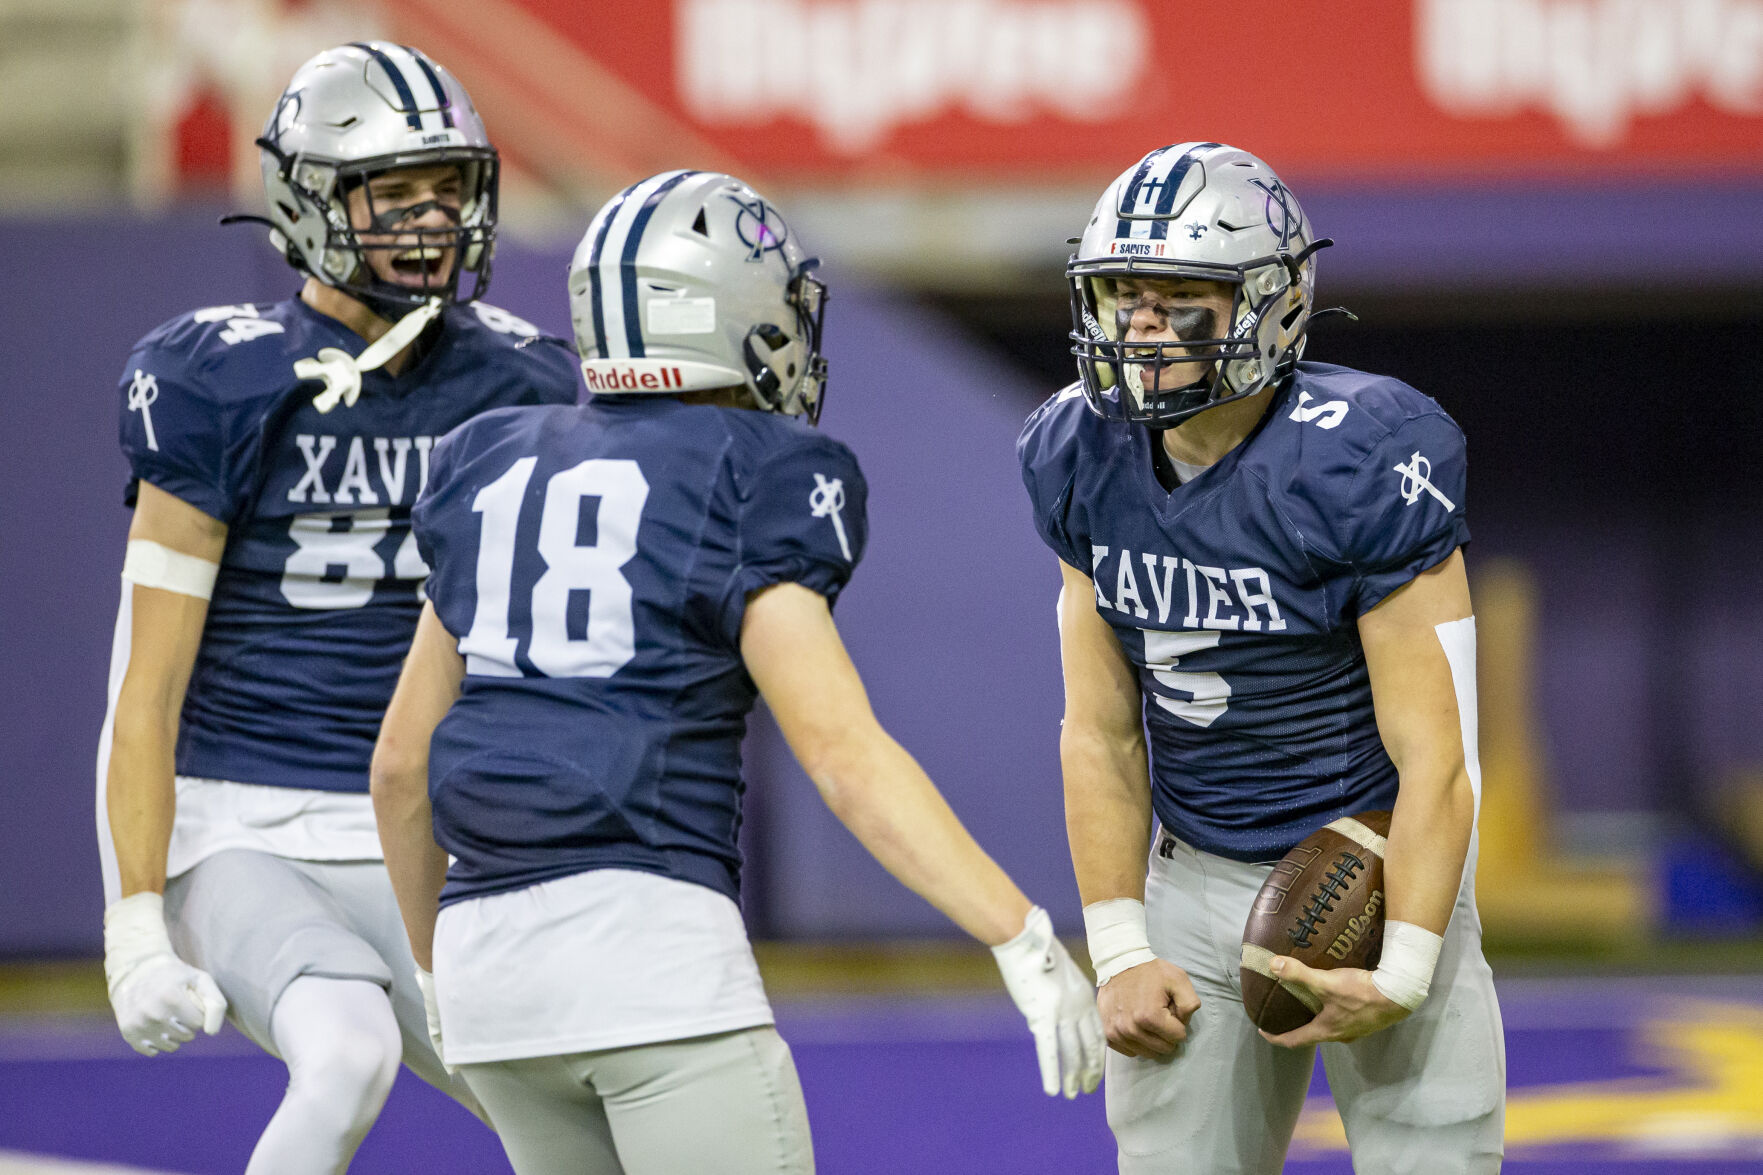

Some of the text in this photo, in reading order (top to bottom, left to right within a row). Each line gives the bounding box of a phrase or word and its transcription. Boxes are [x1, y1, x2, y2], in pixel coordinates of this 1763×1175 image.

[1120, 243, 1151, 255] SAINTS
[586, 367, 682, 389] Riddell
[287, 434, 445, 505] XAVI
[458, 455, 650, 679] 18
[1136, 627, 1232, 728] 5
[1326, 889, 1383, 960] Wilson
